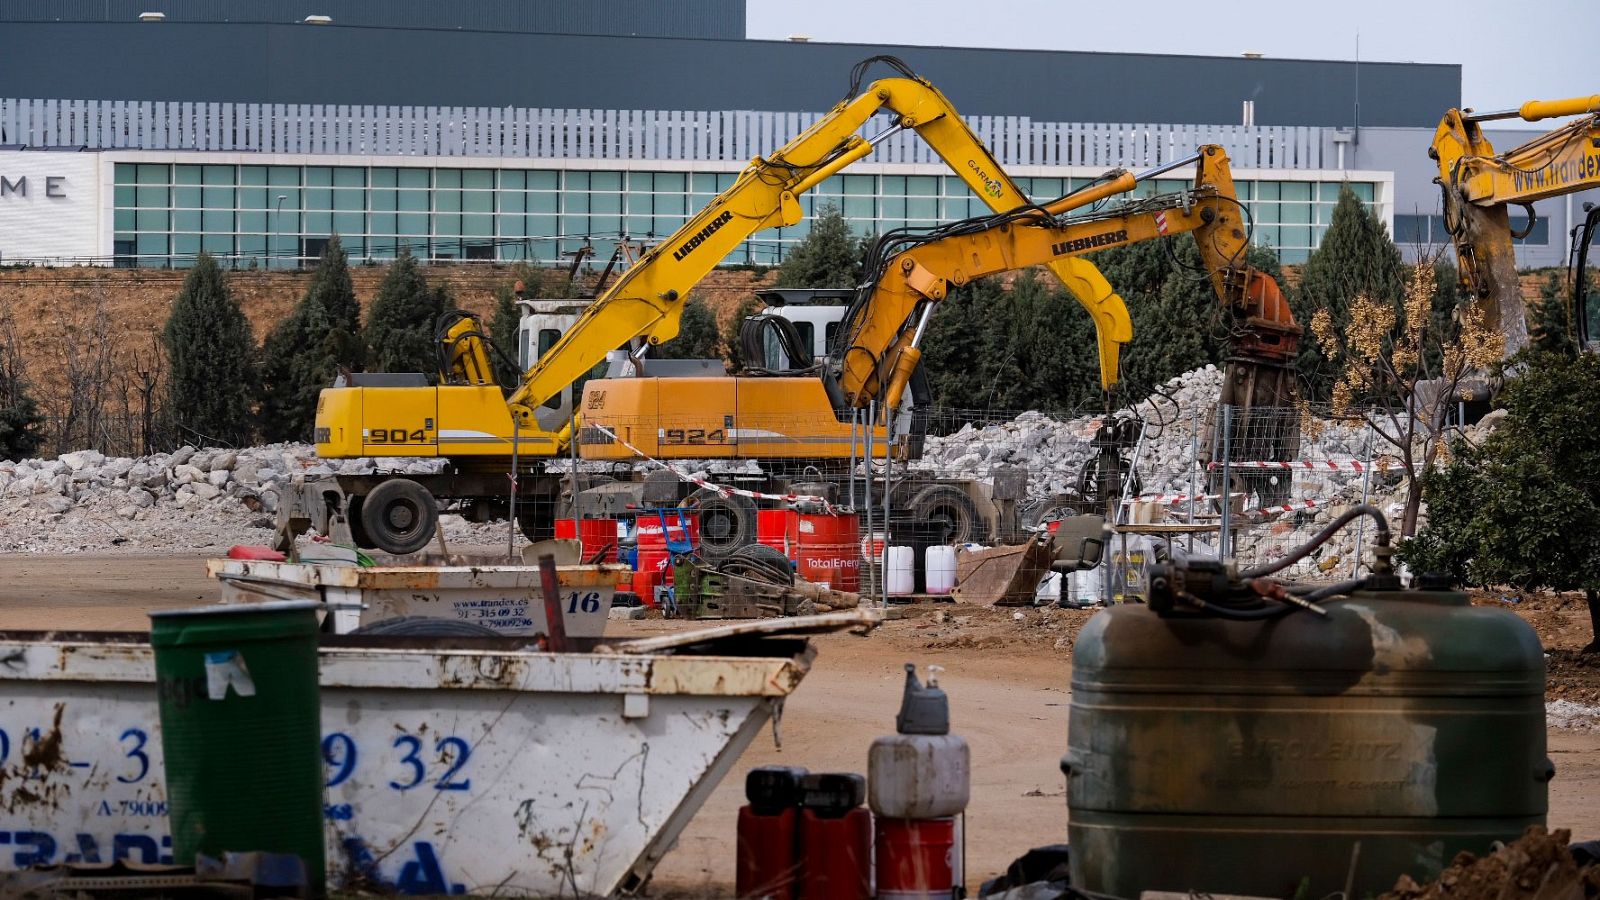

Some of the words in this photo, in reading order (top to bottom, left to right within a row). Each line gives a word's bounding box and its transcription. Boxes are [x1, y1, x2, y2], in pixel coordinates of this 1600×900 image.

[0, 175, 67, 198] ME
[673, 210, 734, 262] LIEBHERR
[1051, 229, 1129, 257] LIEBHERR
[370, 428, 426, 443] 904
[667, 428, 726, 444] 924
[512, 608, 525, 617] 32
[566, 591, 600, 614] 16
[389, 735, 471, 791] 32
